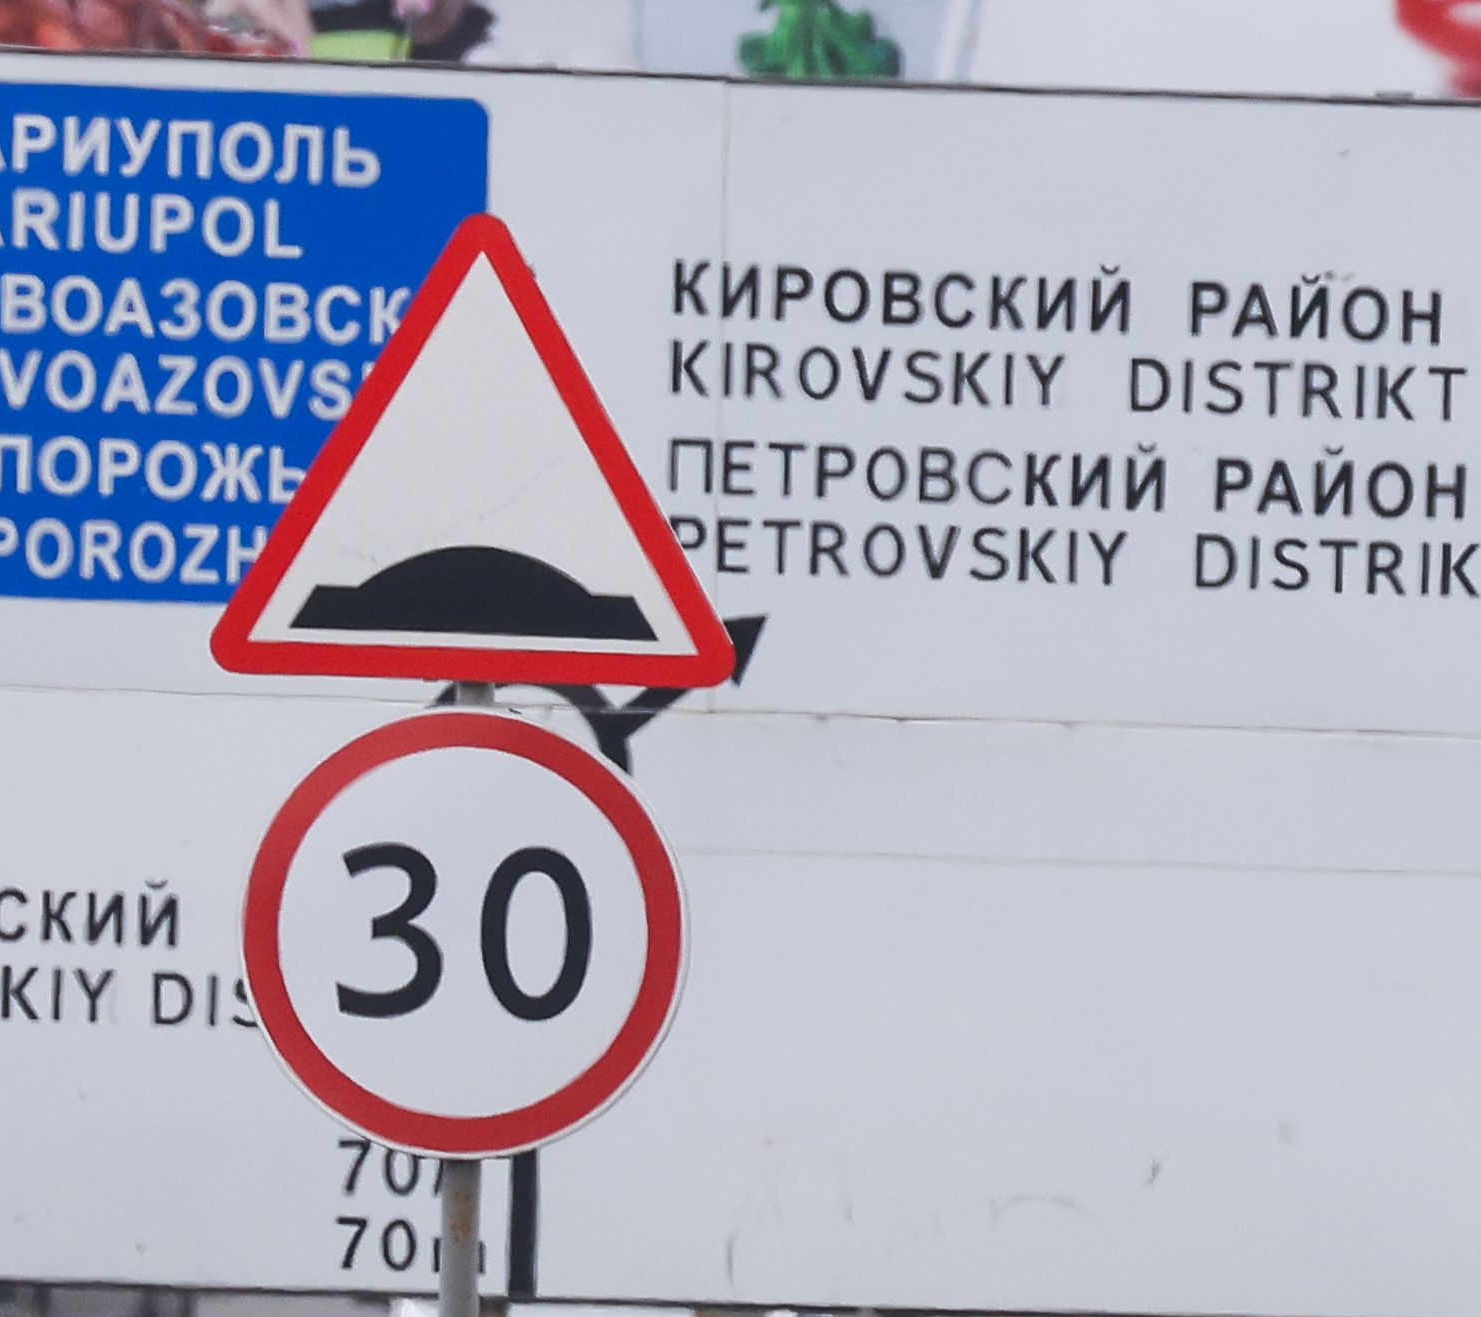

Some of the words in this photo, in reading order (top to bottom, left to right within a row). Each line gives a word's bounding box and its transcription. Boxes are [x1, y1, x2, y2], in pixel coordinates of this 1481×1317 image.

[671, 257, 1132, 334] КИРОВСКИЙ
[1189, 272, 1443, 346] РАЙОН
[670, 339, 1066, 407] KIROVSKIY
[1128, 356, 1469, 422] DISTRIKT
[668, 436, 1167, 513] ПЕТРОВСКИЙ
[1213, 446, 1468, 520] РАЙОН
[668, 514, 1129, 586] PETROVSKIY
[334, 841, 594, 1023] 30
[337, 1136, 445, 1196] 70
